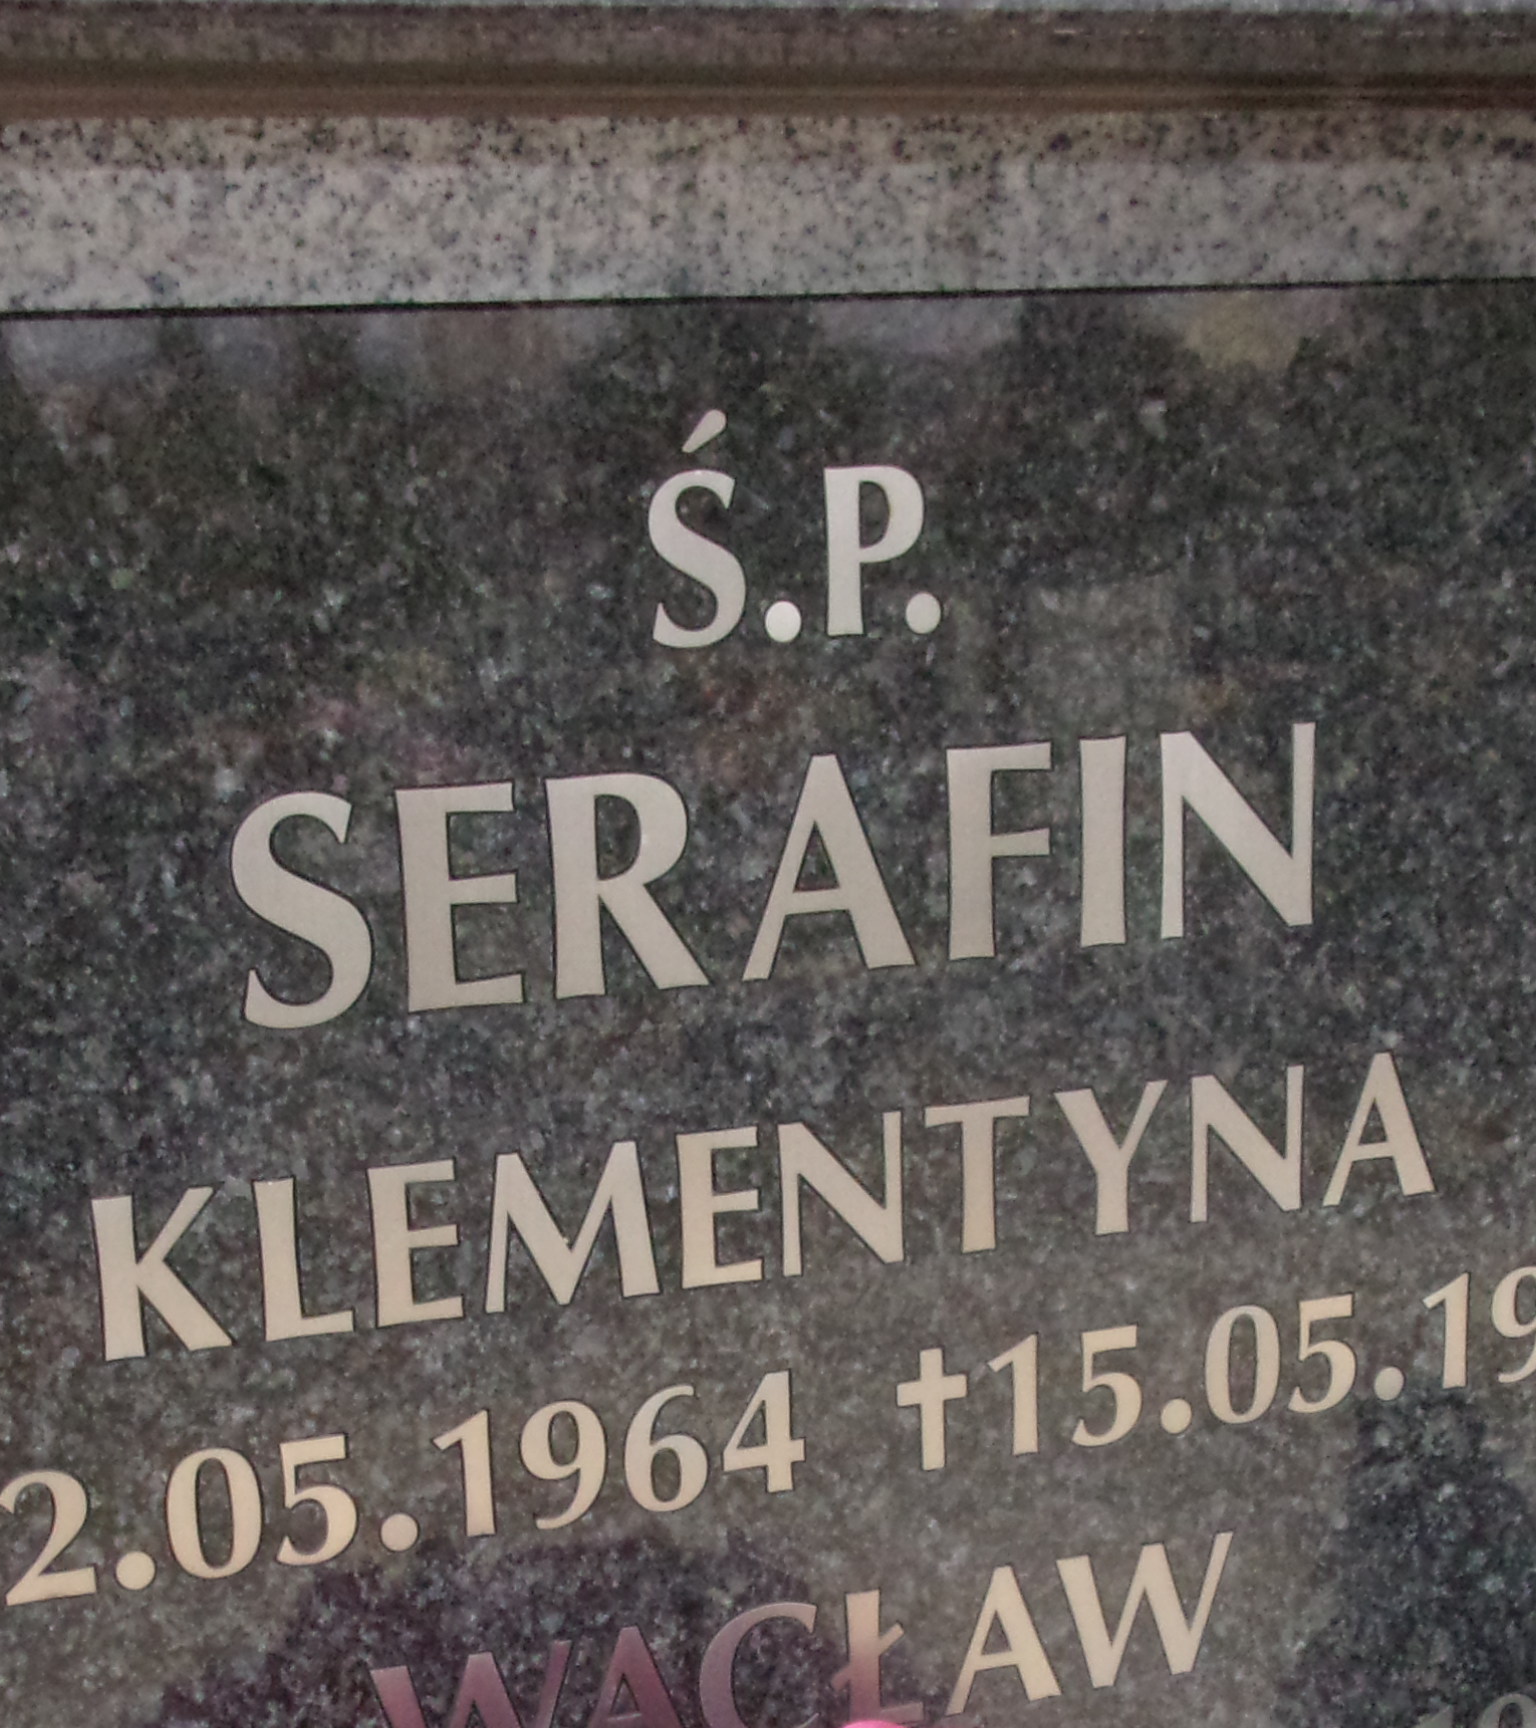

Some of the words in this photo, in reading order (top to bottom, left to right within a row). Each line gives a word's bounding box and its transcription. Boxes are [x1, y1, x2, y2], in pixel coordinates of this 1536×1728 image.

[650, 409, 944, 650] Ś.P.
[230, 720, 1318, 1030] SERAFIN
[89, 1049, 1435, 1362] KLEMENTYNA
